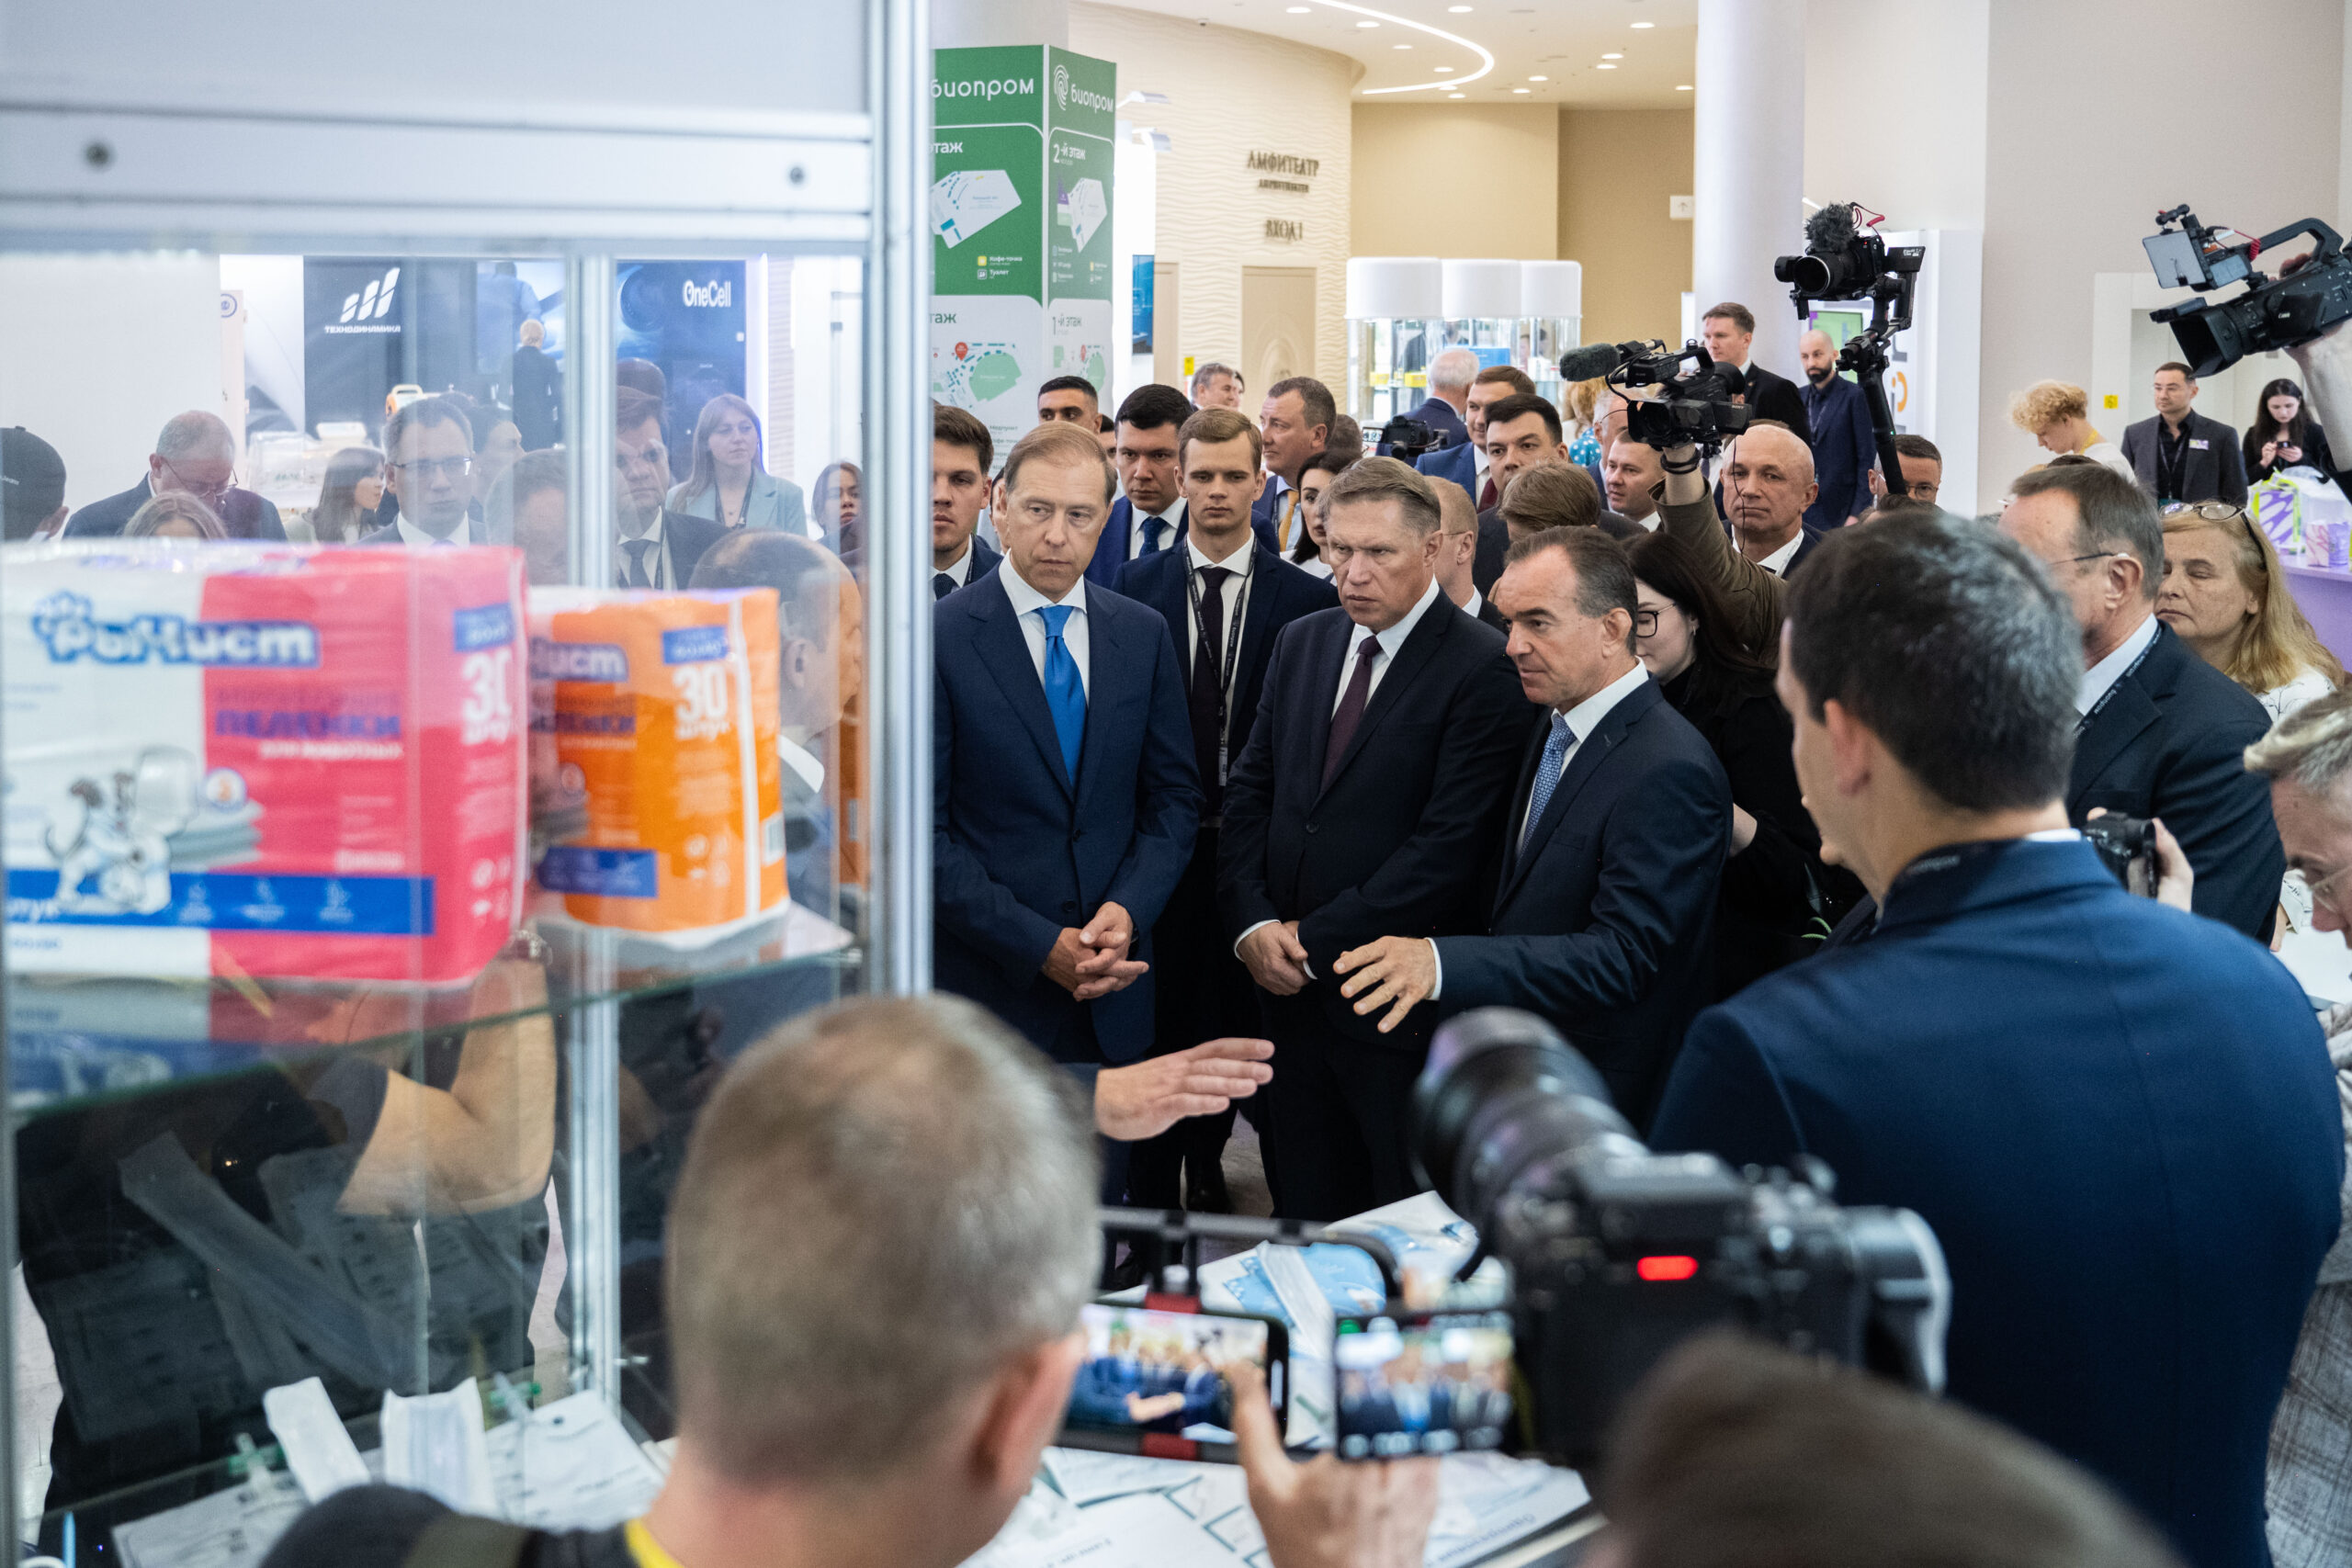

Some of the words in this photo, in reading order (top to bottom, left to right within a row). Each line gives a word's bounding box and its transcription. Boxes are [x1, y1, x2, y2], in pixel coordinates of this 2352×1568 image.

[930, 78, 1035, 101] биопром
[1070, 84, 1114, 114] биопром
[1247, 150, 1319, 177] АМФИТЕАТР
[1265, 219, 1297, 242] ВХОД
[683, 279, 731, 308] OneCell
[324, 324, 401, 334] ТЕХНОДИНАМИКА
[927, 312, 957, 324] таж
[673, 664, 729, 724] 30
